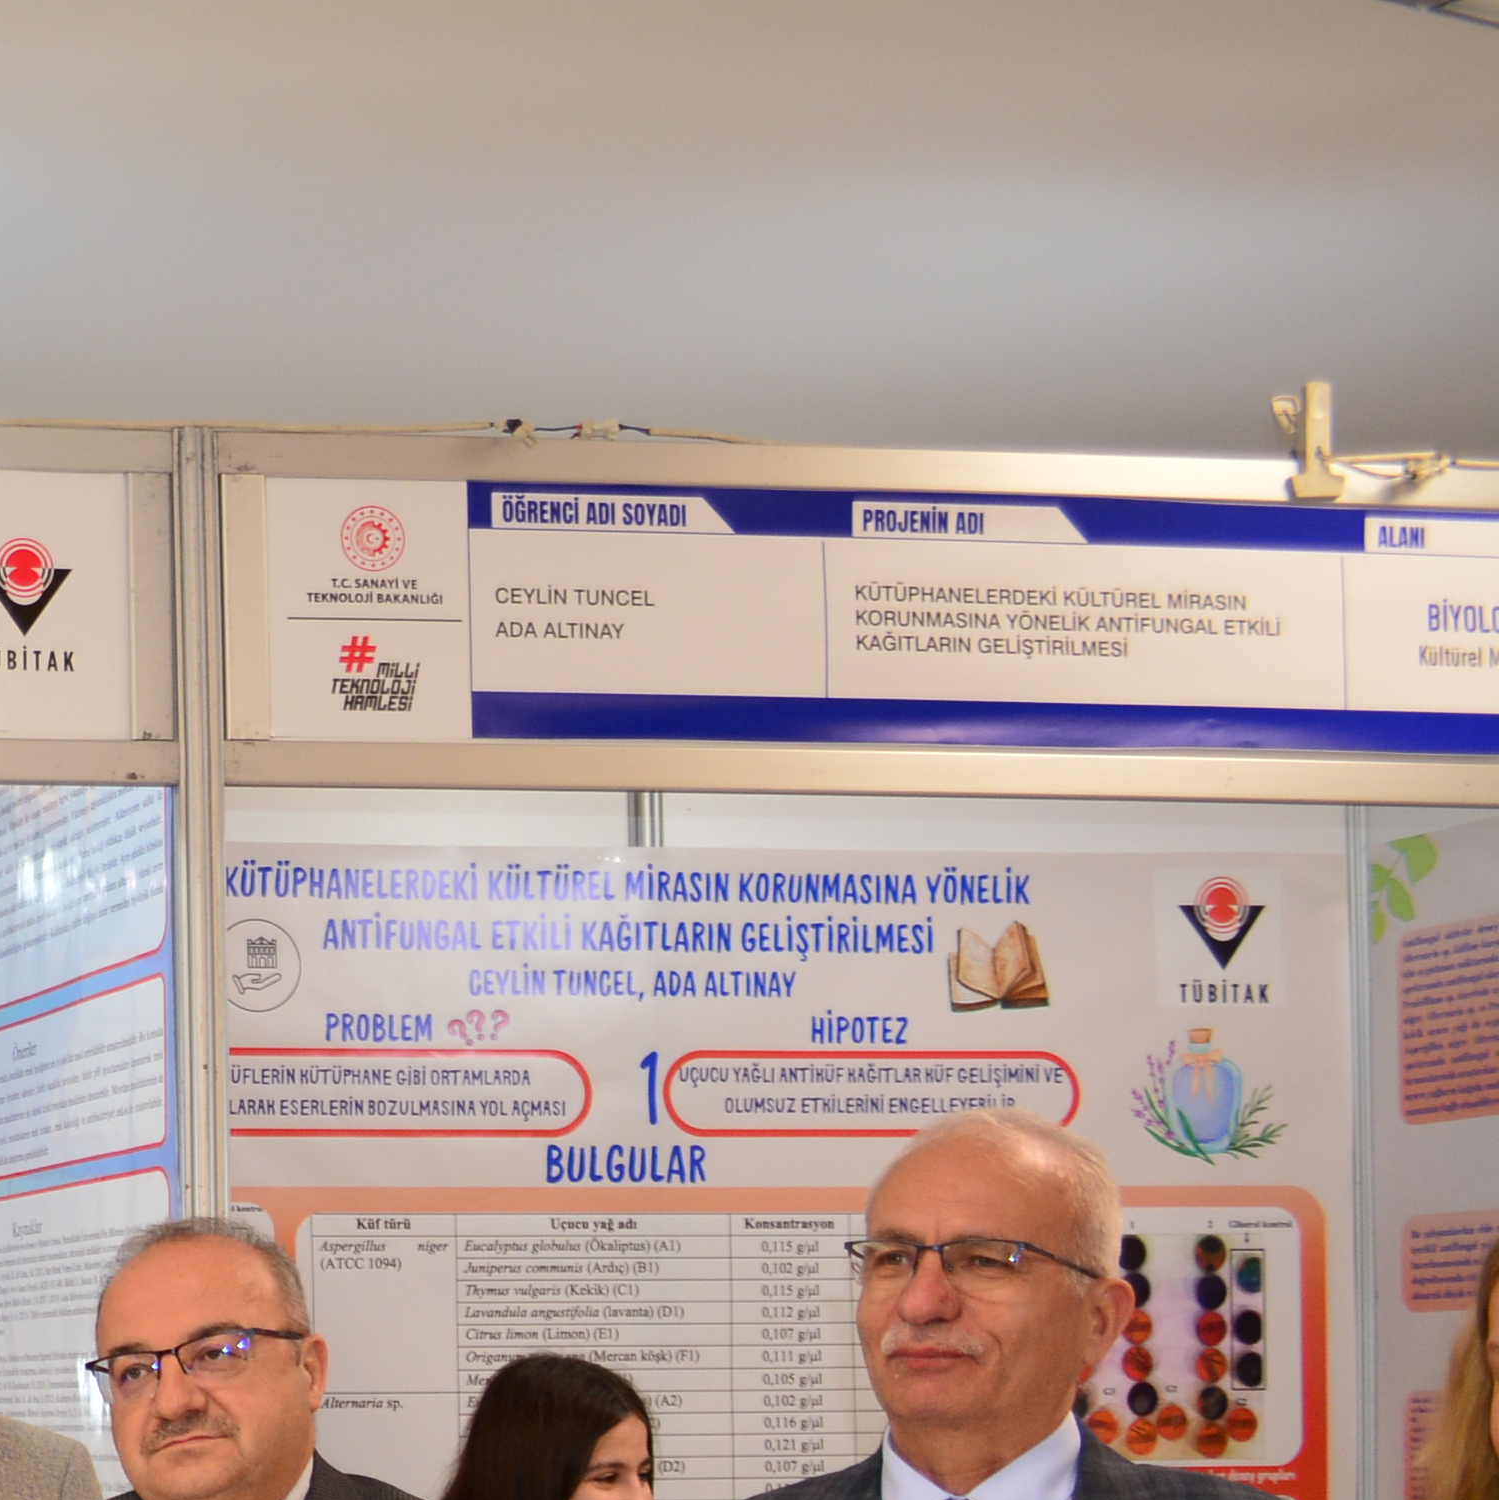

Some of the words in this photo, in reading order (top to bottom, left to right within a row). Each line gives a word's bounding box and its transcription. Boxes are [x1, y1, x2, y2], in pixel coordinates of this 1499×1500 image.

[503, 495, 579, 524] ÖĞRENCİ
[587, 502, 615, 525] ADI
[623, 503, 686, 527] SOYADI
[863, 506, 948, 533] PROJENİN
[956, 512, 984, 534] ADI
[1379, 526, 1424, 548] ALANI
[495, 585, 567, 604] CEYLİN
[573, 589, 655, 606] TUNCEL
[855, 581, 1056, 605] KÜTÜPHANELERDEKİ
[1064, 587, 1162, 609] KÜLTÜREL
[1168, 590, 1248, 610] MİRASIN
[496, 622, 537, 638] ADA
[544, 622, 624, 639] ALTINAY
[856, 610, 1001, 629] KORUNMASINA
[1006, 610, 1090, 631] YÖNELİK
[1096, 613, 1219, 635] ANTİFUNGAL
[1224, 617, 1281, 636] ETKİLİ
[856, 631, 971, 653] KAĞITLARIN
[978, 635, 1128, 659] GELİŞTİRİLMESİ
[1419, 645, 1482, 667] Kültürel
[226, 860, 478, 902] KÜTÜPHANELERDEKİ
[488, 863, 616, 902] KÜLTÜREL
[625, 864, 729, 903] MİRASIN
[739, 872, 917, 905] KORUNMASINA
[925, 866, 1030, 905] YÖNELİK
[323, 911, 483, 951] ANTİFUNGAL
[491, 912, 573, 952] ETKİLİ
[582, 914, 732, 954] KAĞITLARIN
[741, 915, 934, 961] GELİŞTİRİLMESİ
[470, 964, 545, 995] CEYLİN
[553, 970, 644, 1001] TUNCEL,
[654, 971, 696, 997] ADA
[705, 971, 796, 997] ALTINAY
[326, 1013, 432, 1042] PROBLEM
[812, 1010, 908, 1045] HİPOTEZ
[547, 1145, 705, 1183] BULGULAR
[744, 1217, 834, 1233] Konsantrasyon
[320, 1240, 386, 1255] Aspergillus
[418, 1241, 449, 1255] niger
[465, 1305, 527, 1319] Lavandula
[530, 1305, 599, 1322] angustifolia
[603, 1305, 655, 1320] (lavanta)
[657, 1305, 685, 1320] (D1)
